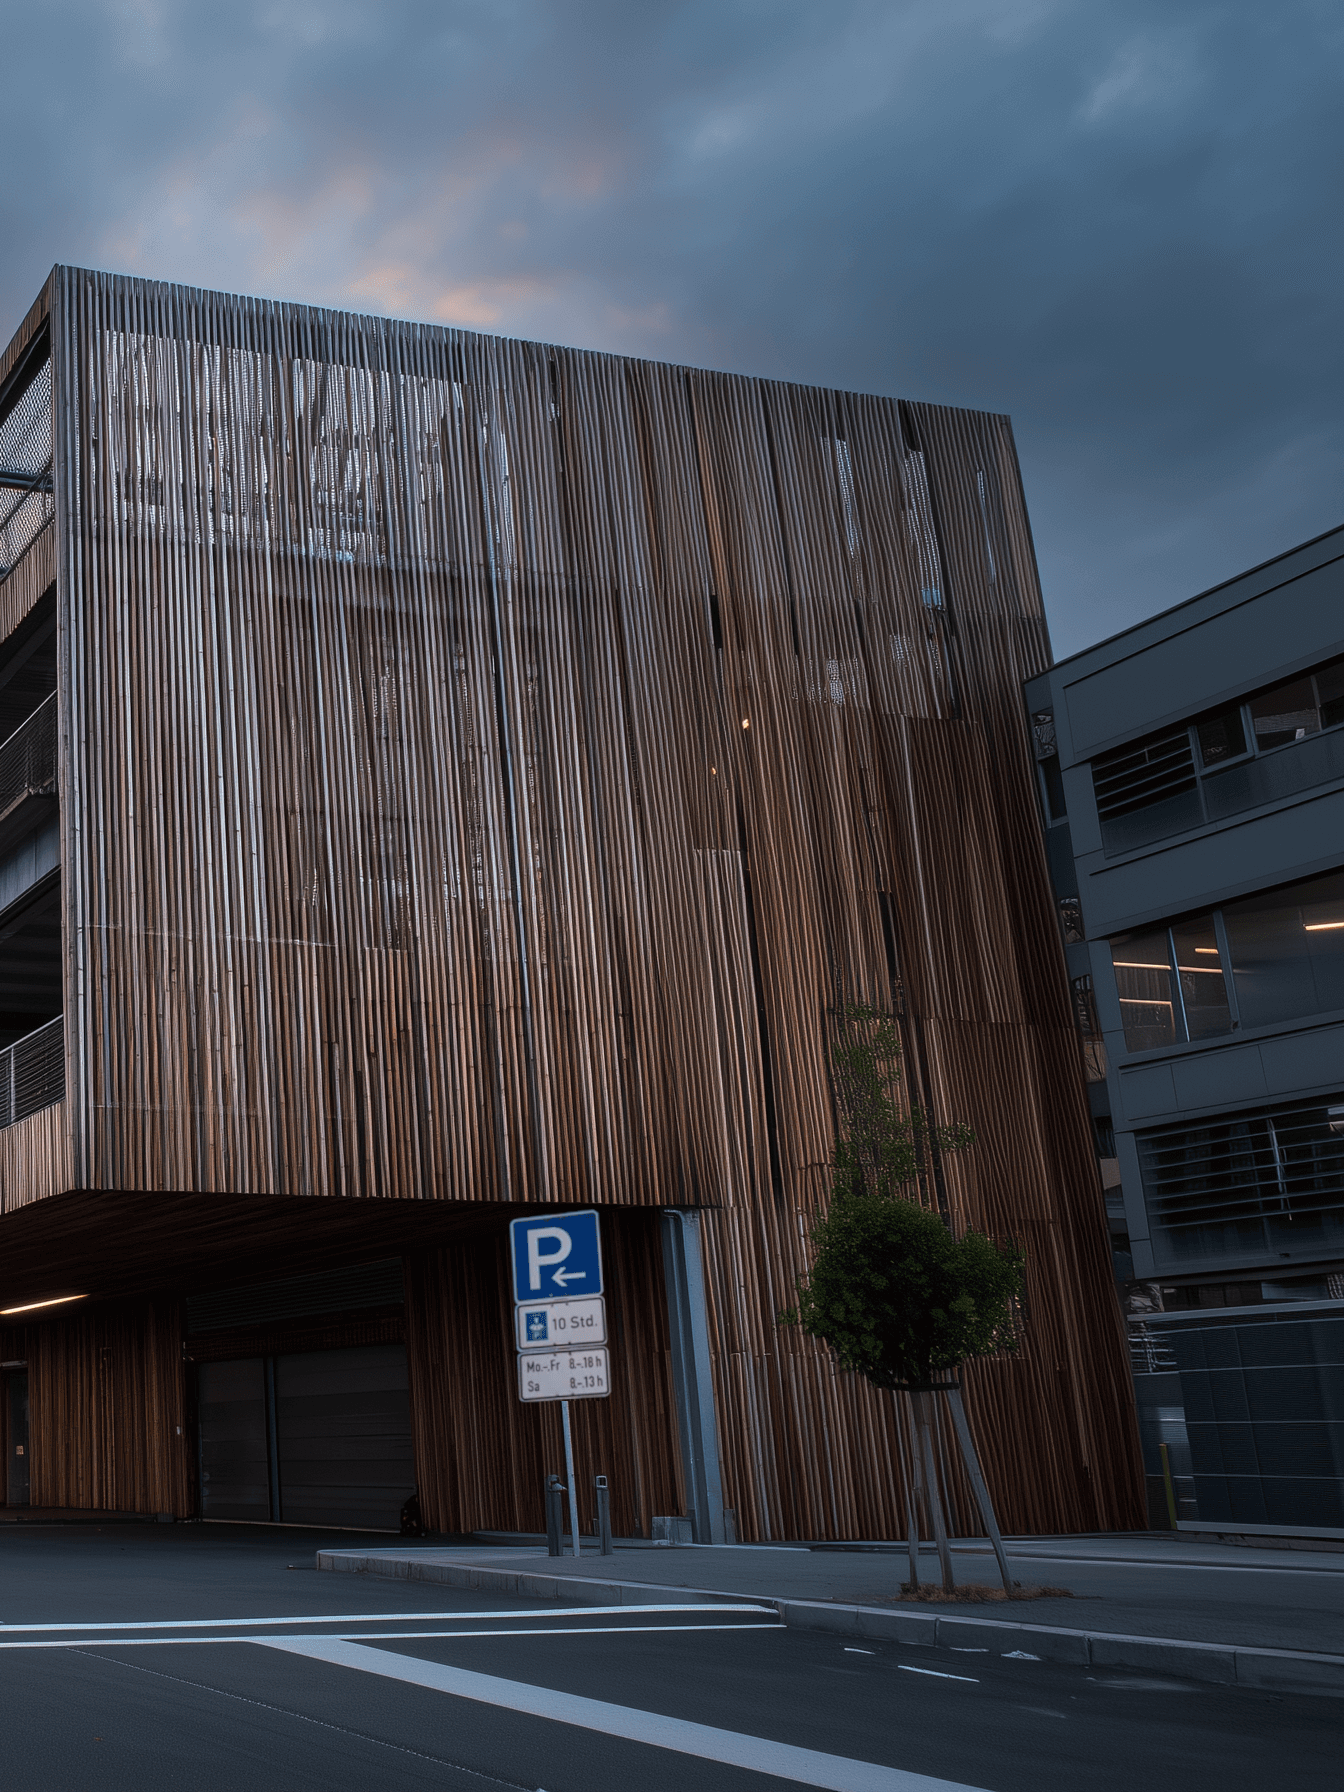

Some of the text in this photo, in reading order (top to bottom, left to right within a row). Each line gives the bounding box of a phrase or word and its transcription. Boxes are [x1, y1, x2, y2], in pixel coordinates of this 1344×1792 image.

[526, 1226, 573, 1291] P
[552, 1314, 598, 1331] 10 Std.
[527, 1380, 540, 1392] Sa
